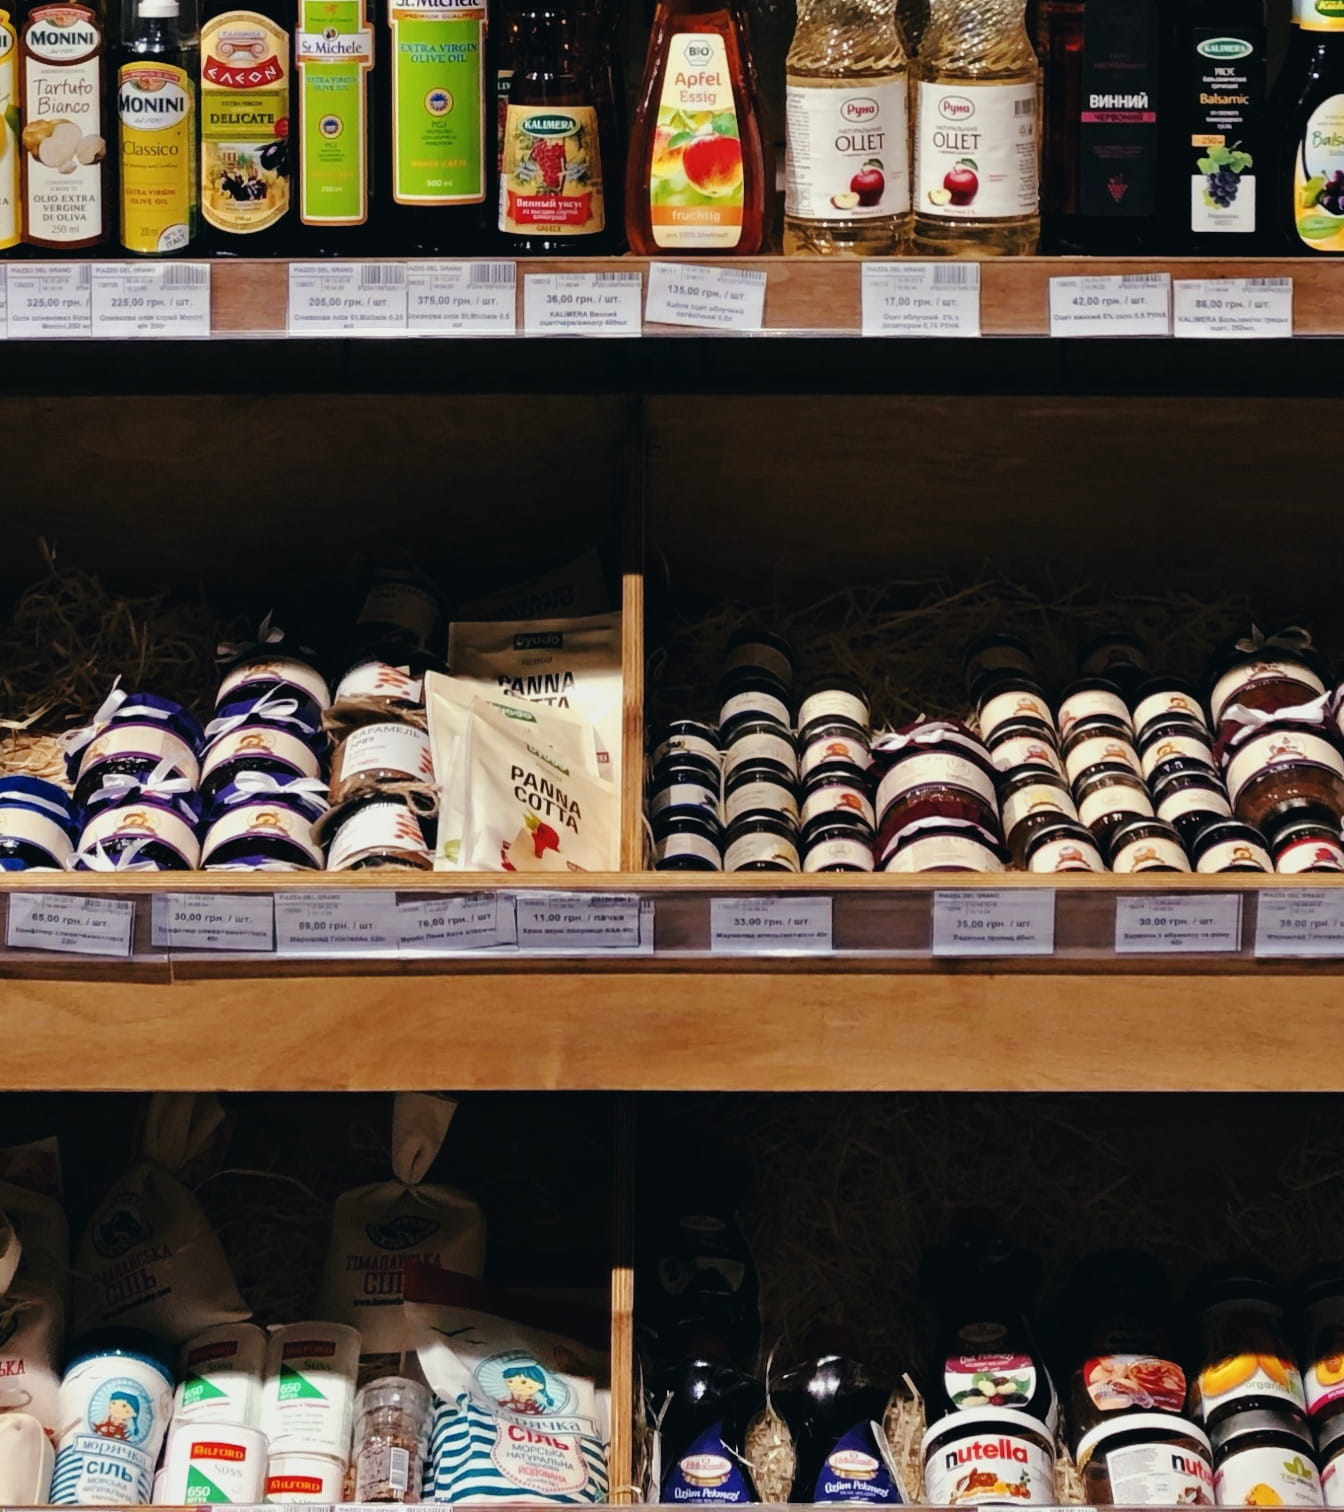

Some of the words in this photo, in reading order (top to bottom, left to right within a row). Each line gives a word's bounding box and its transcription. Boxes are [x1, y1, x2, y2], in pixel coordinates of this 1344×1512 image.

[30, 31, 94, 46] MONINI
[400, 42, 435, 53] EXTRA
[439, 42, 478, 53] VIRGIN
[411, 53, 443, 64] OLIVE
[447, 53, 467, 64] OIL
[32, 79, 93, 96] Tartufo
[675, 70, 722, 88] Apfel
[37, 97, 90, 116] Bianco
[119, 96, 185, 113] MONINI
[680, 90, 716, 107] Essig
[1089, 93, 1149, 110] ВИННИЙ
[1199, 92, 1249, 105] Balsamic
[847, 102, 873, 117] Руна
[210, 113, 275, 126] DELICATE
[524, 119, 575, 132] KALIMERA
[123, 140, 179, 158] Classico
[835, 132, 886, 152] ОЦЕТ
[933, 131, 981, 150] ОЦЕТ
[510, 765, 582, 818] PANNA
[513, 785, 581, 834] COTTA
[508, 1425, 567, 1450] СІЛЬ
[194, 1444, 244, 1461] MILFORD
[946, 1441, 1028, 1469] nutella
[87, 1460, 133, 1484] СІЛЬ
[270, 1479, 319, 1493] MILFORD
